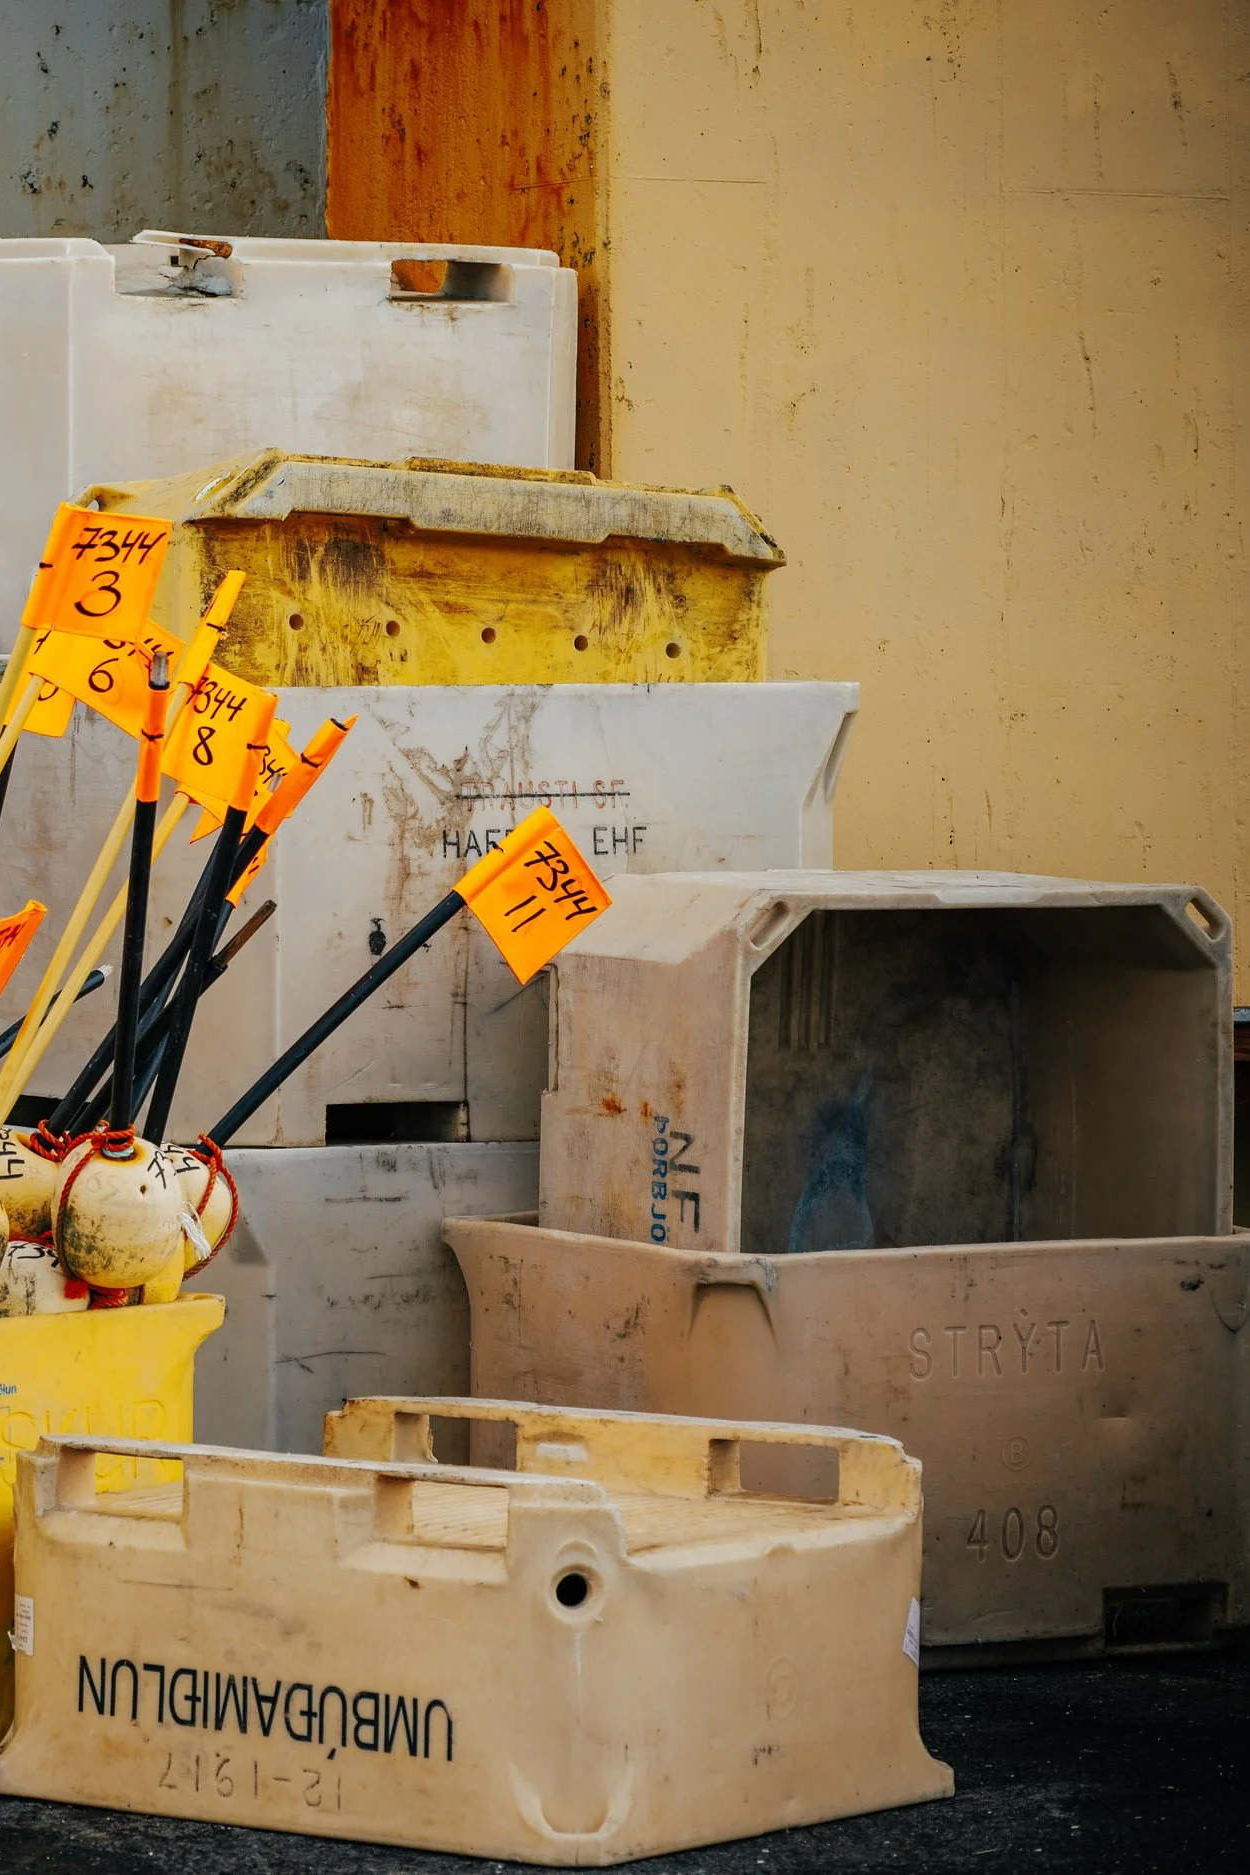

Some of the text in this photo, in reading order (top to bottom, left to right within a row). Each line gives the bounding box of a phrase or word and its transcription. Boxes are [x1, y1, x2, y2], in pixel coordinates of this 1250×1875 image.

[72, 527, 167, 565] 7344
[74, 570, 123, 617] 3
[88, 658, 120, 693] 6
[186, 676, 248, 722] 7344
[192, 726, 216, 766] 8
[592, 826, 648, 856] EHF
[524, 841, 598, 921] 7344
[503, 895, 546, 932] 11
[966, 1504, 1060, 1563] 408
[78, 1655, 454, 1762] UMBÚÐAMIÐLUN
